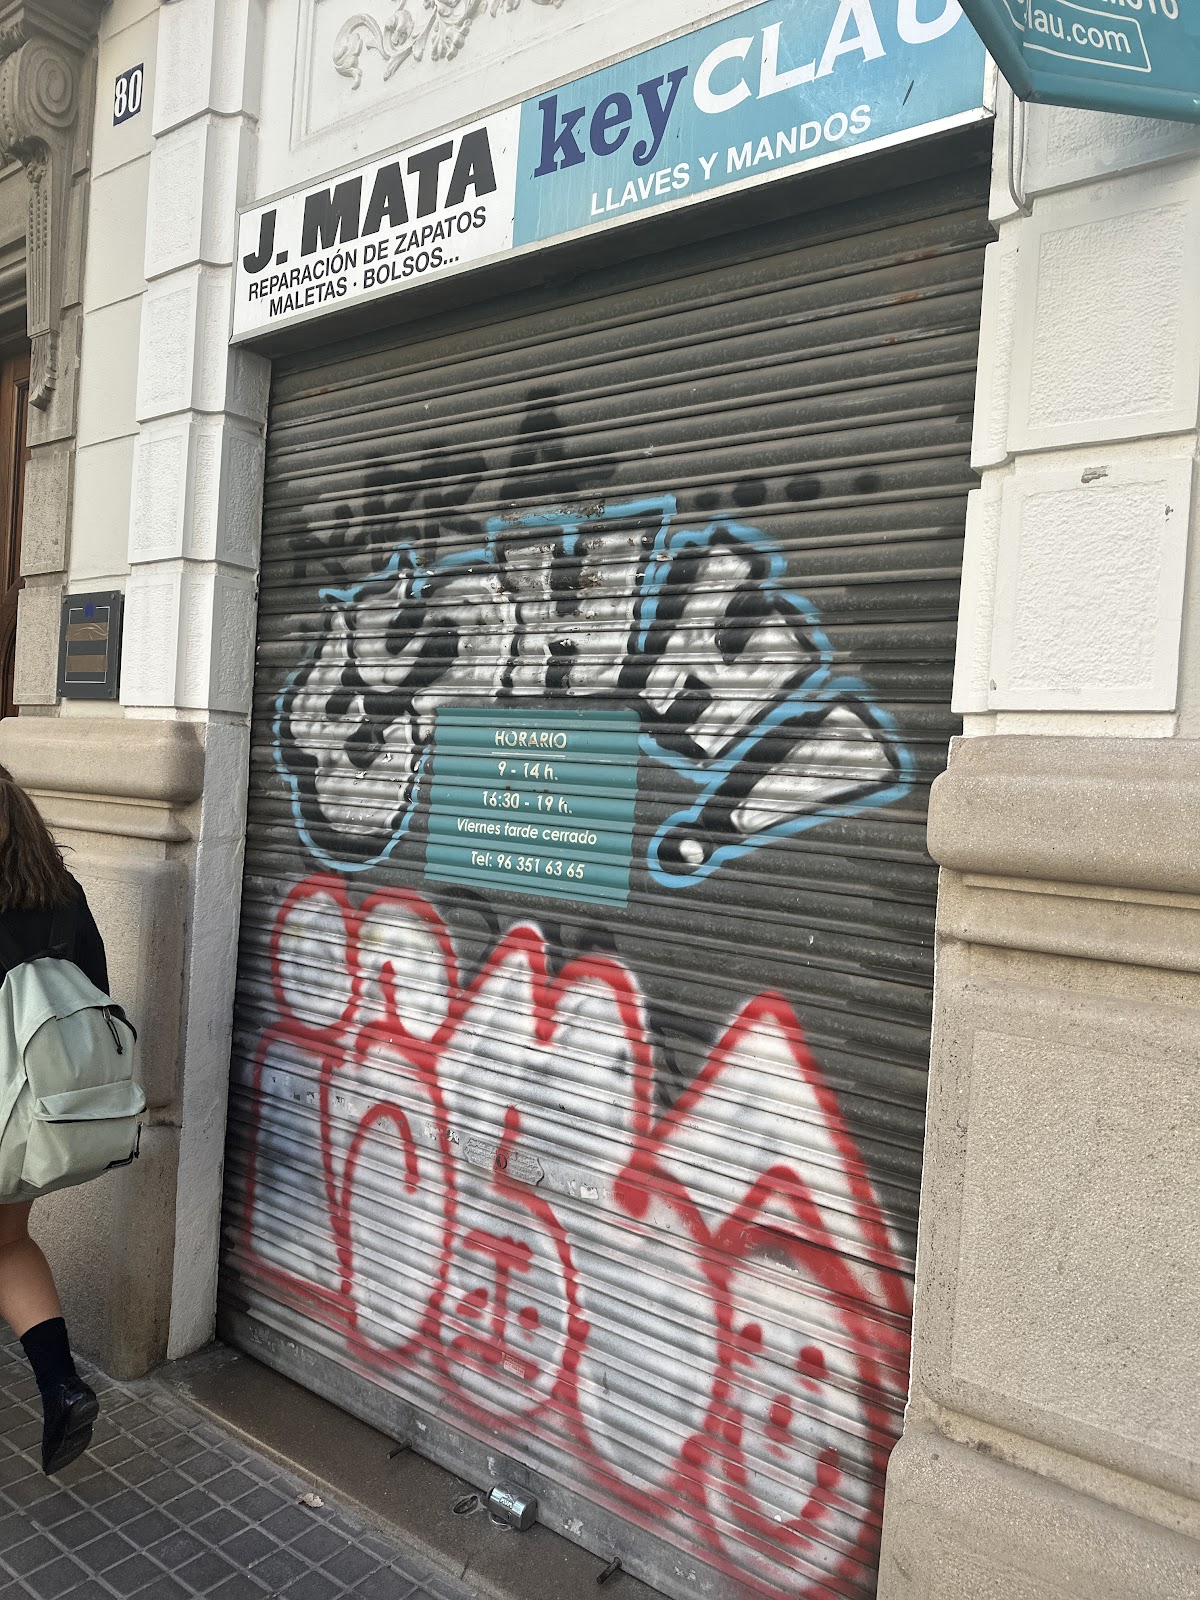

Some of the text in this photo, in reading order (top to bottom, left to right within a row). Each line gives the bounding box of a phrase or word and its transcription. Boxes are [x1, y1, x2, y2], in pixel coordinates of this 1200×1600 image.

[114, 69, 143, 118] 80
[590, 104, 871, 216] LLAVES Y MANDOS
[243, 127, 497, 274] J. MATA
[248, 205, 487, 302] REPARACIÓN DE ZAPATOS
[269, 276, 348, 318] MALETAS
[363, 246, 460, 290] BOLSOS...
[494, 730, 567, 749] HORARIO
[498, 760, 507, 777] 9
[523, 762, 540, 779] 14
[544, 763, 559, 781] h.
[482, 790, 520, 809] 16:30
[537, 795, 554, 812] 19
[558, 796, 573, 814] h.
[457, 818, 598, 845] Viernes tarde cerrado
[471, 850, 586, 879] Tel: 96 351 63 65
